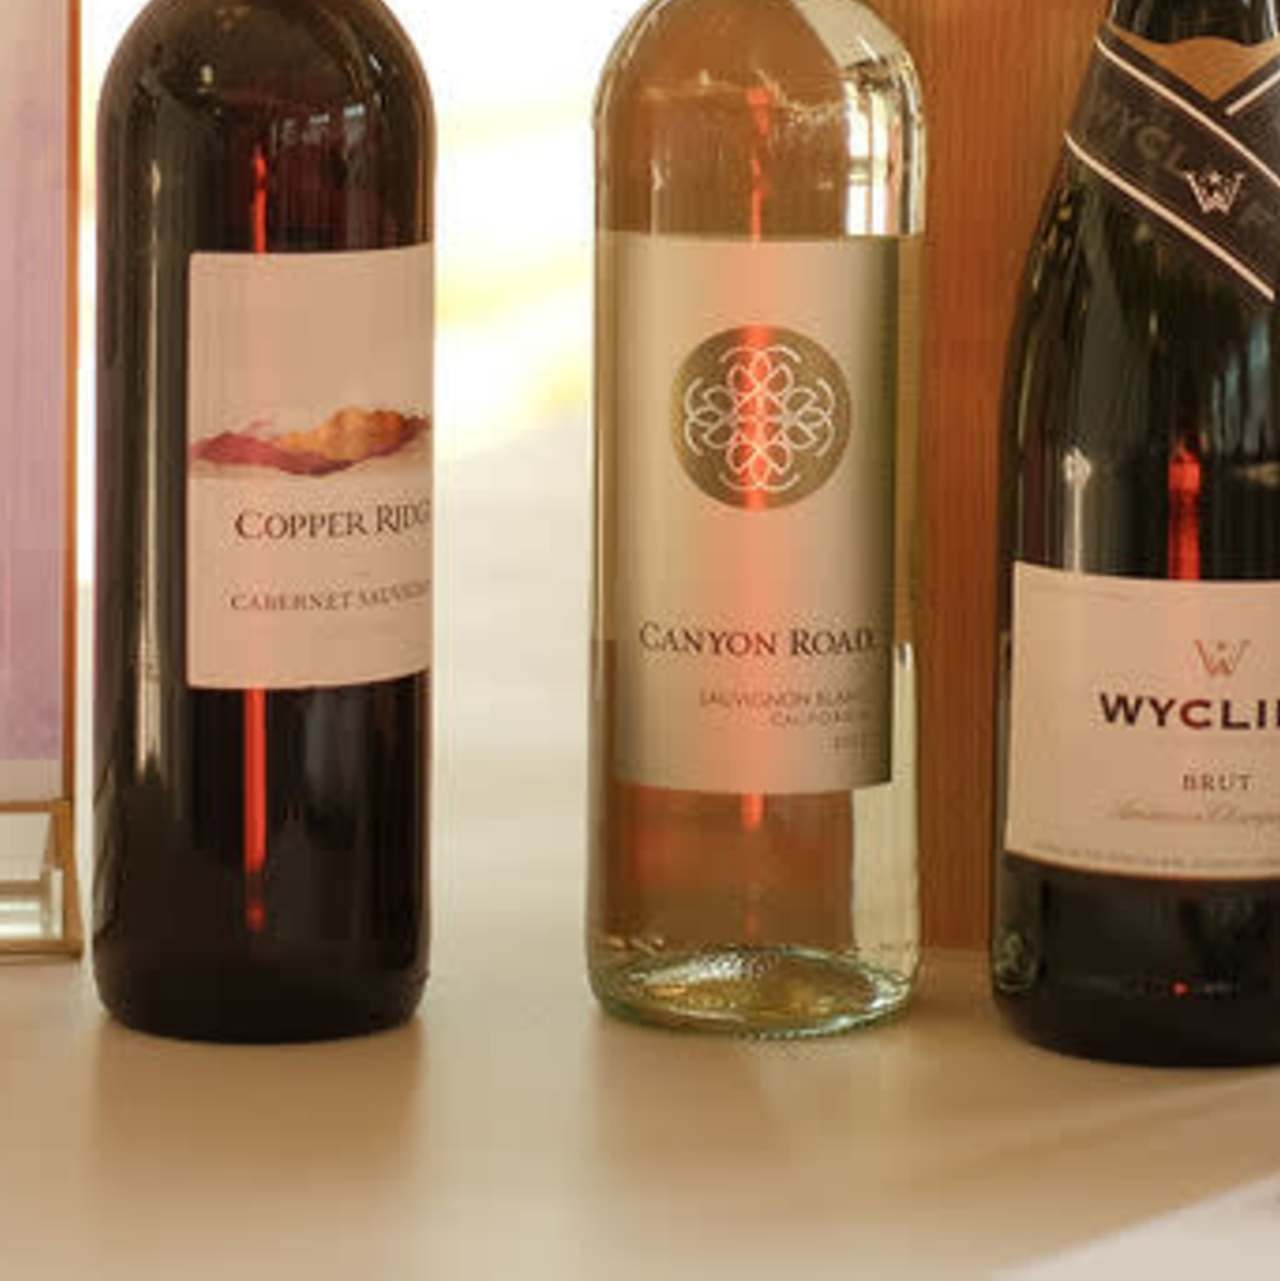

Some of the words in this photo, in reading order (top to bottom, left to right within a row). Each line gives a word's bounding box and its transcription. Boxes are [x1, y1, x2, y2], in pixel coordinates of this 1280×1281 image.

[234, 505, 369, 540] COPPER
[376, 498, 431, 535] RIDG
[230, 589, 352, 612] CABERNET
[639, 620, 777, 657] CANYON
[788, 626, 877, 657] ROAD
[1181, 773, 1253, 793] BRUT
